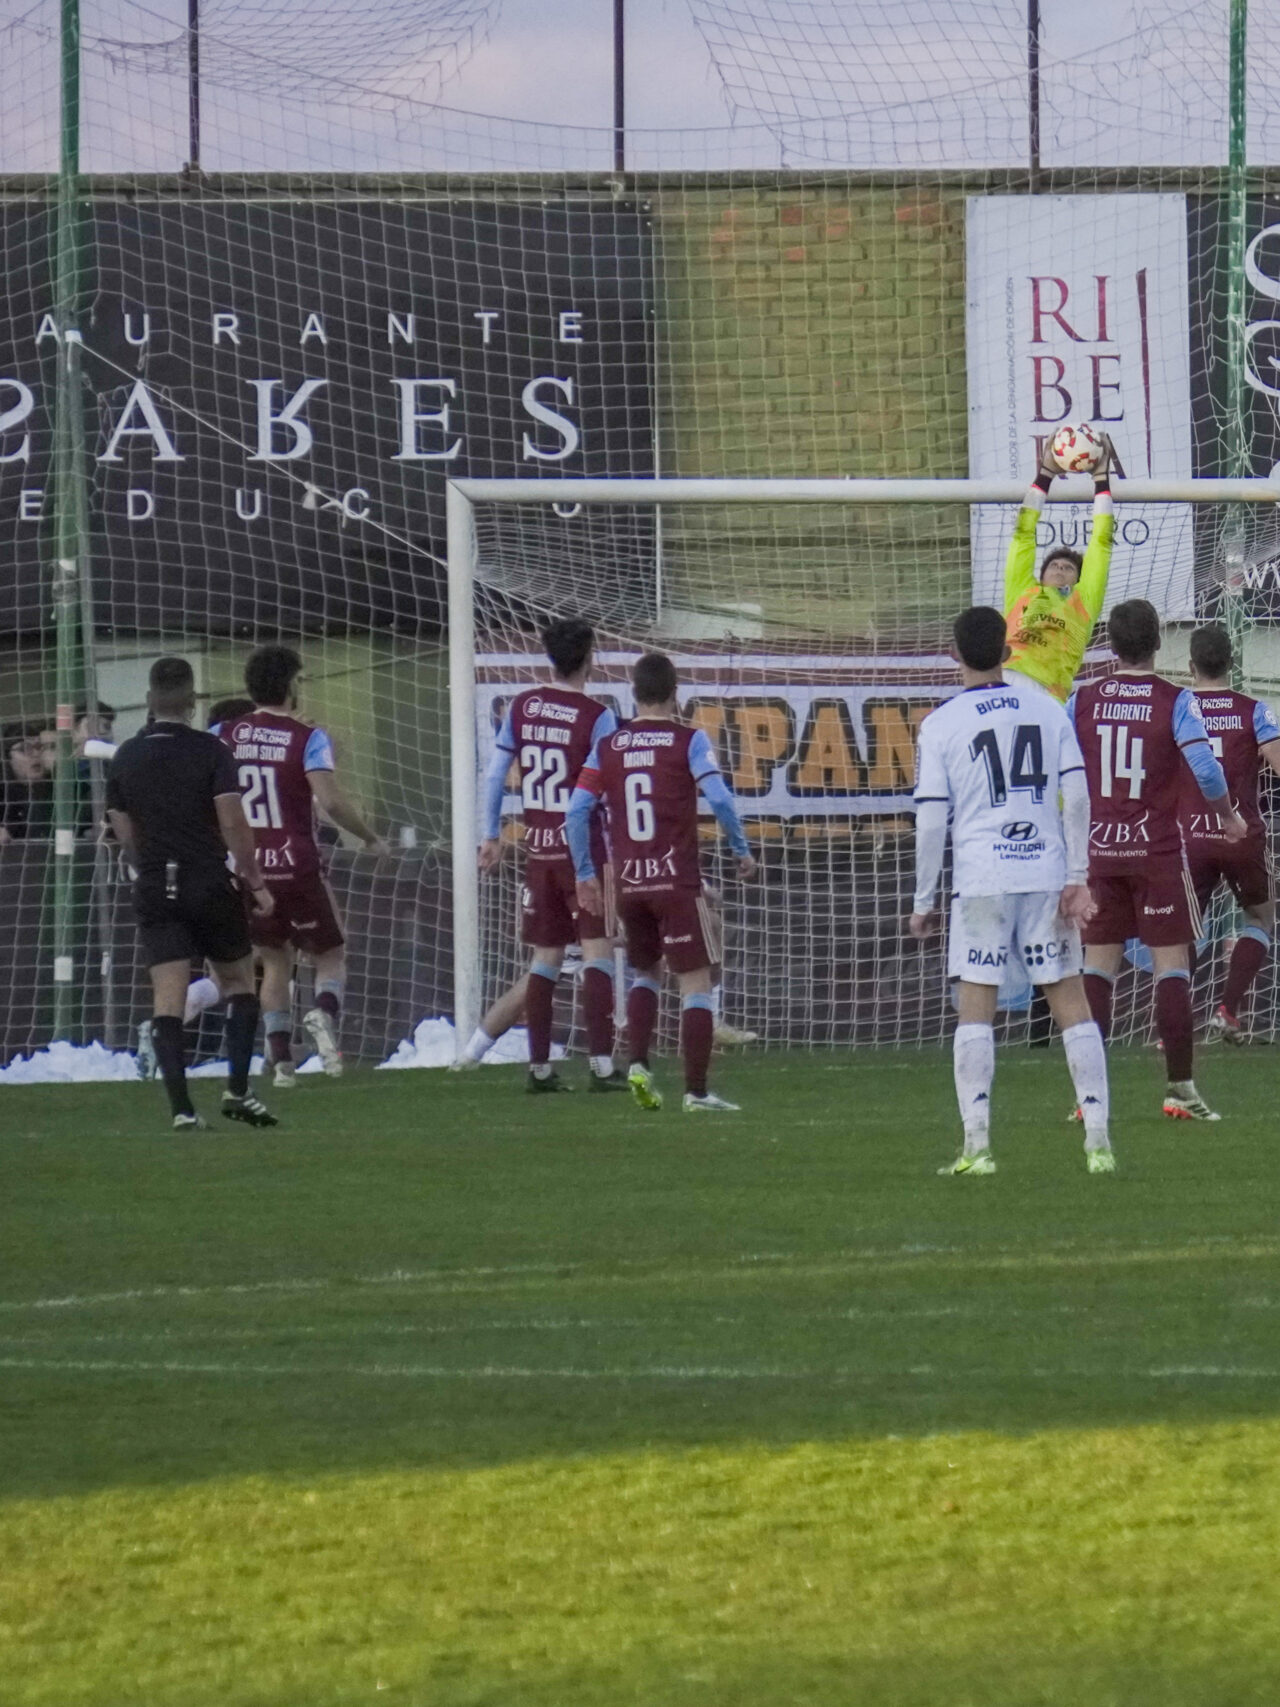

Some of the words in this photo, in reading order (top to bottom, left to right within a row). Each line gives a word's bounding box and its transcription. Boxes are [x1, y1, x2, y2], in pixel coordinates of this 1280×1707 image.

[1118, 688, 1152, 698] PALOMO
[975, 697, 1020, 716] BICHO
[1102, 703, 1153, 722] LLORENTE
[521, 724, 534, 740] DE
[535, 726, 546, 742] LA
[631, 737, 674, 747] PALOMO
[233, 744, 258, 760] JUAN
[259, 745, 287, 762] SILVA
[623, 750, 655, 768] MANU
[1096, 724, 1146, 800] 14
[968, 724, 1048, 808] 14
[520, 745, 570, 813] 22
[238, 764, 283, 829] 21
[624, 773, 655, 841] 6
[993, 842, 1046, 852] HYUNDAI
[1118, 849, 1148, 858] EVENTOS
[620, 845, 678, 885] ZIBÁ
